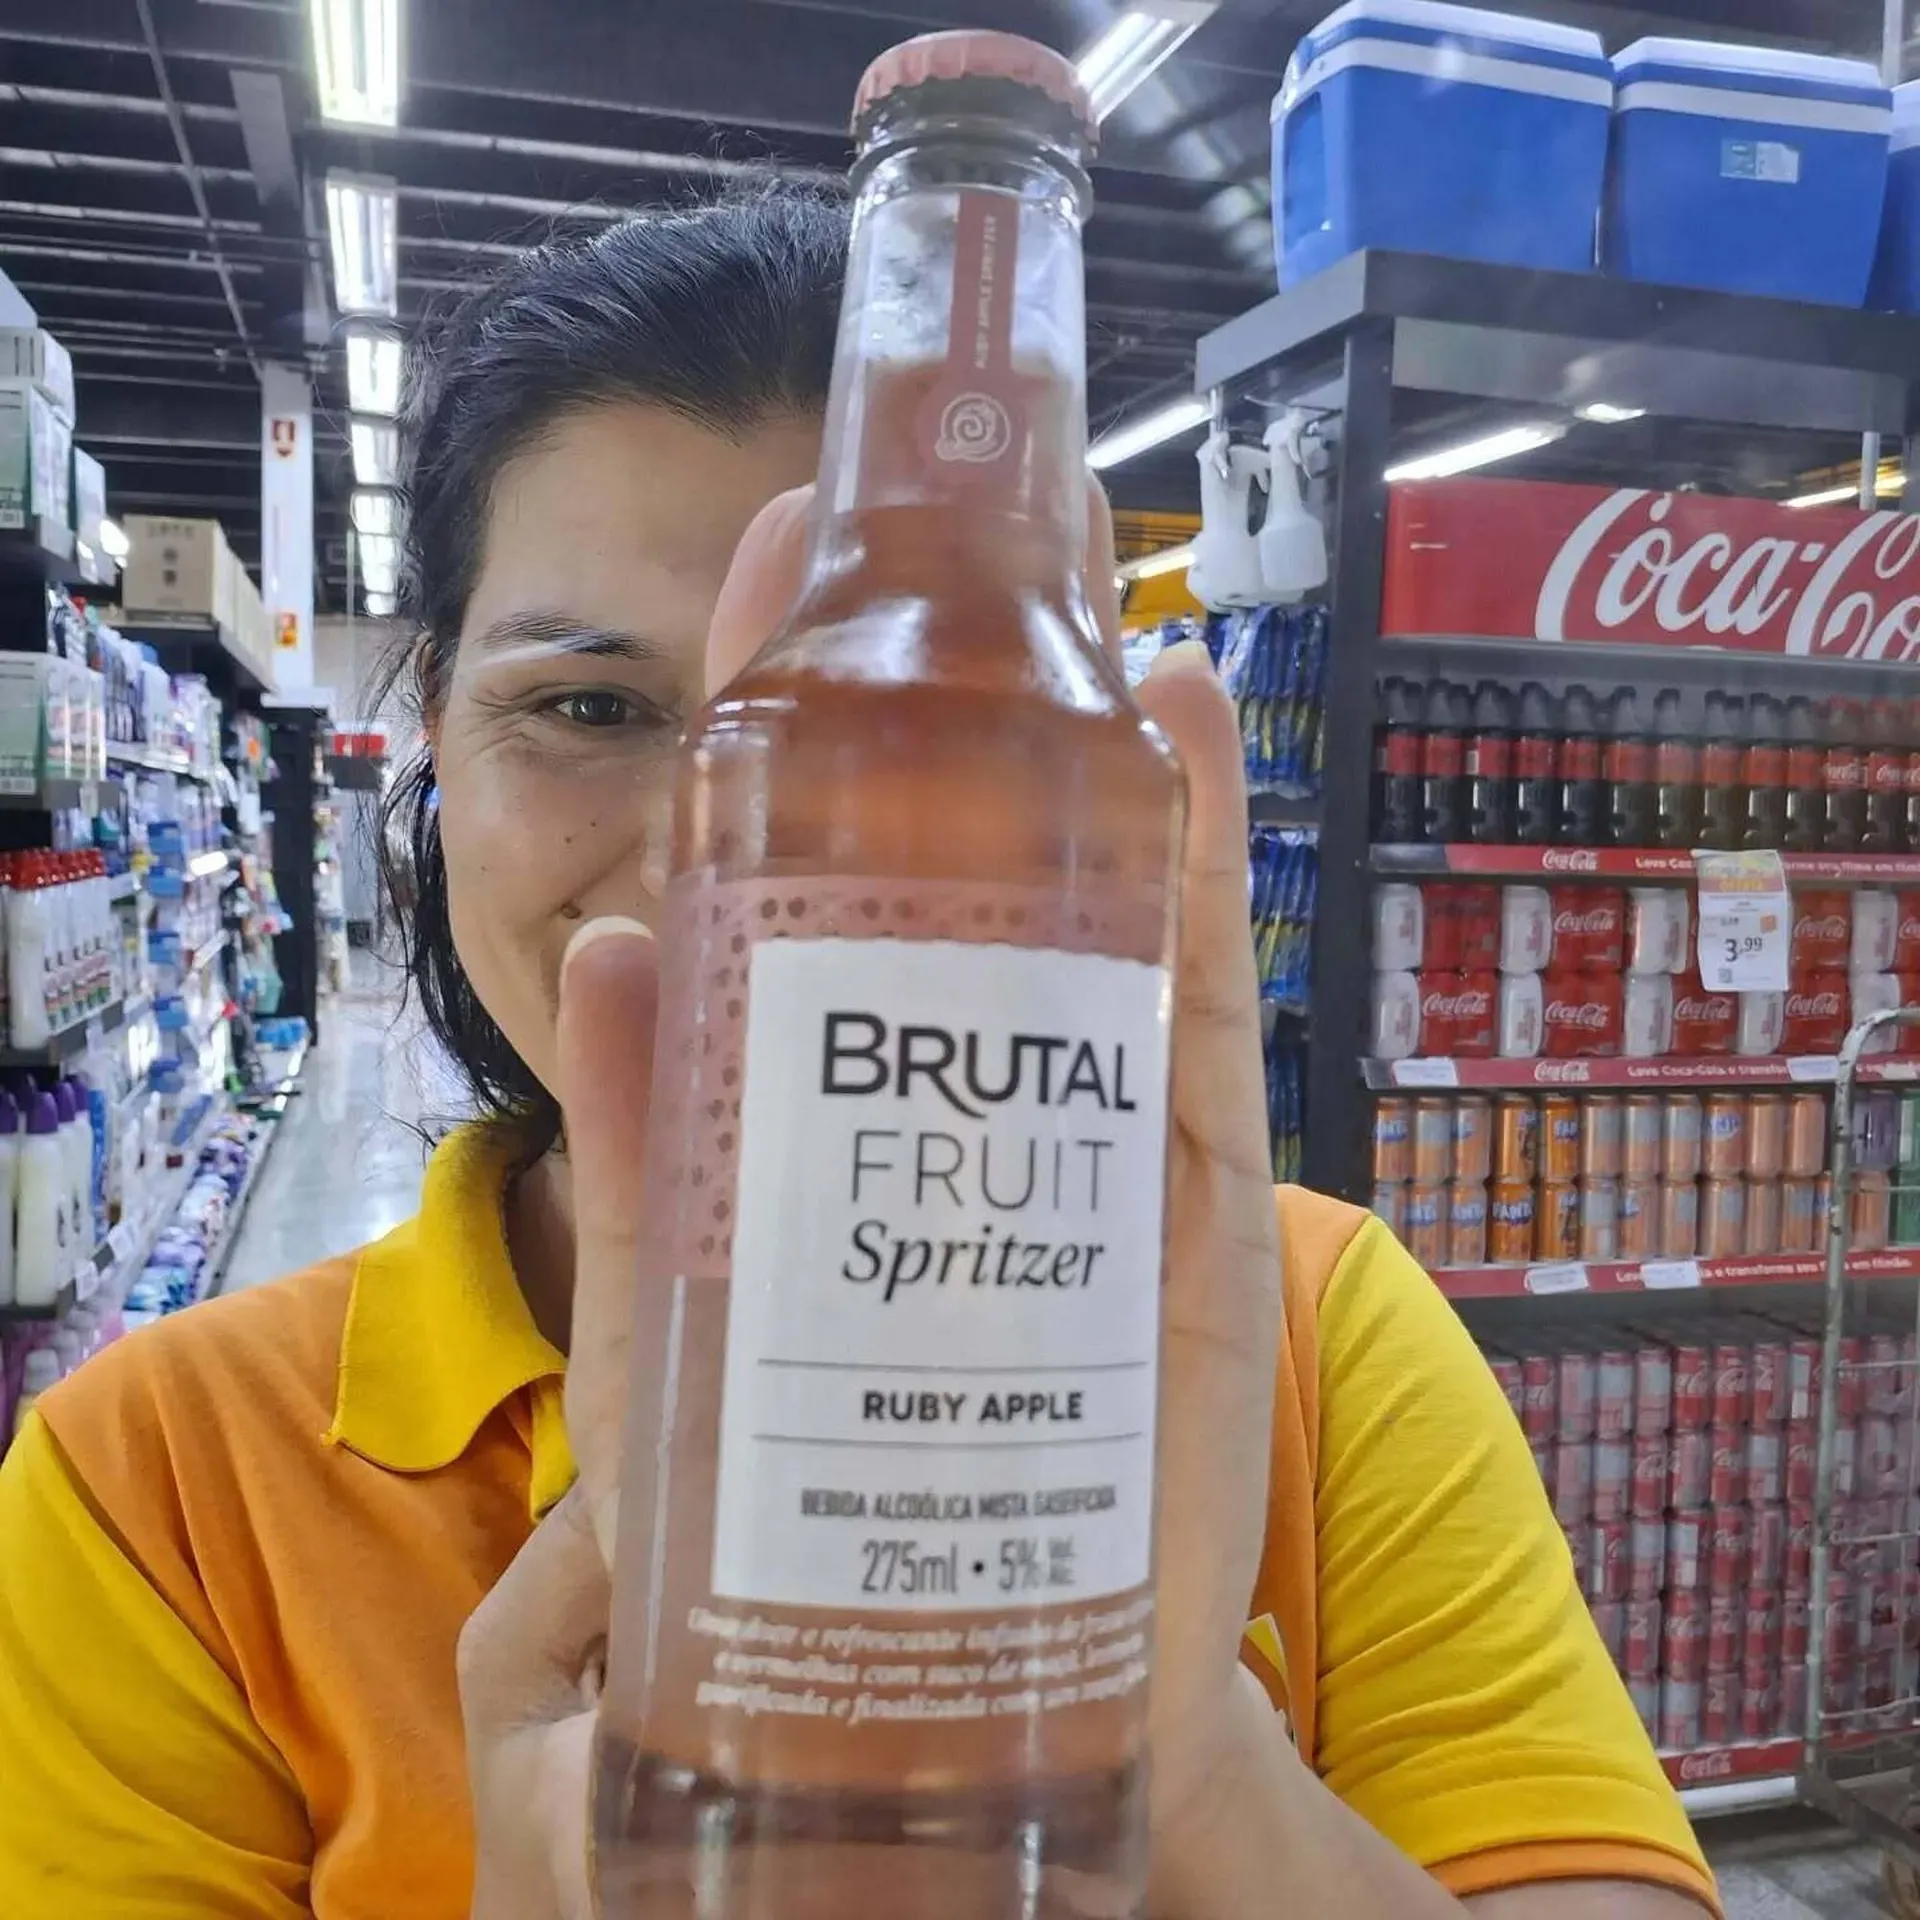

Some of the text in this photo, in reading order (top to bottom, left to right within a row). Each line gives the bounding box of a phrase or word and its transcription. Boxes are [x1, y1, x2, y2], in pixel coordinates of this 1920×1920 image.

[1542, 849, 1598, 871] Coca-Cola
[1554, 909, 1616, 935] Coca-Cola
[1423, 992, 1491, 1019] Coca-Cola
[1545, 1001, 1610, 1031] Coca-Cola
[822, 1011, 1137, 1119] BRUTAL
[1534, 1060, 1590, 1082] Coca-Cola
[851, 1130, 1114, 1212] FRUIT
[842, 1220, 1105, 1303] Spritzer
[863, 1390, 1087, 1423] RUBY APPLE
[861, 1538, 958, 1593] 275ml
